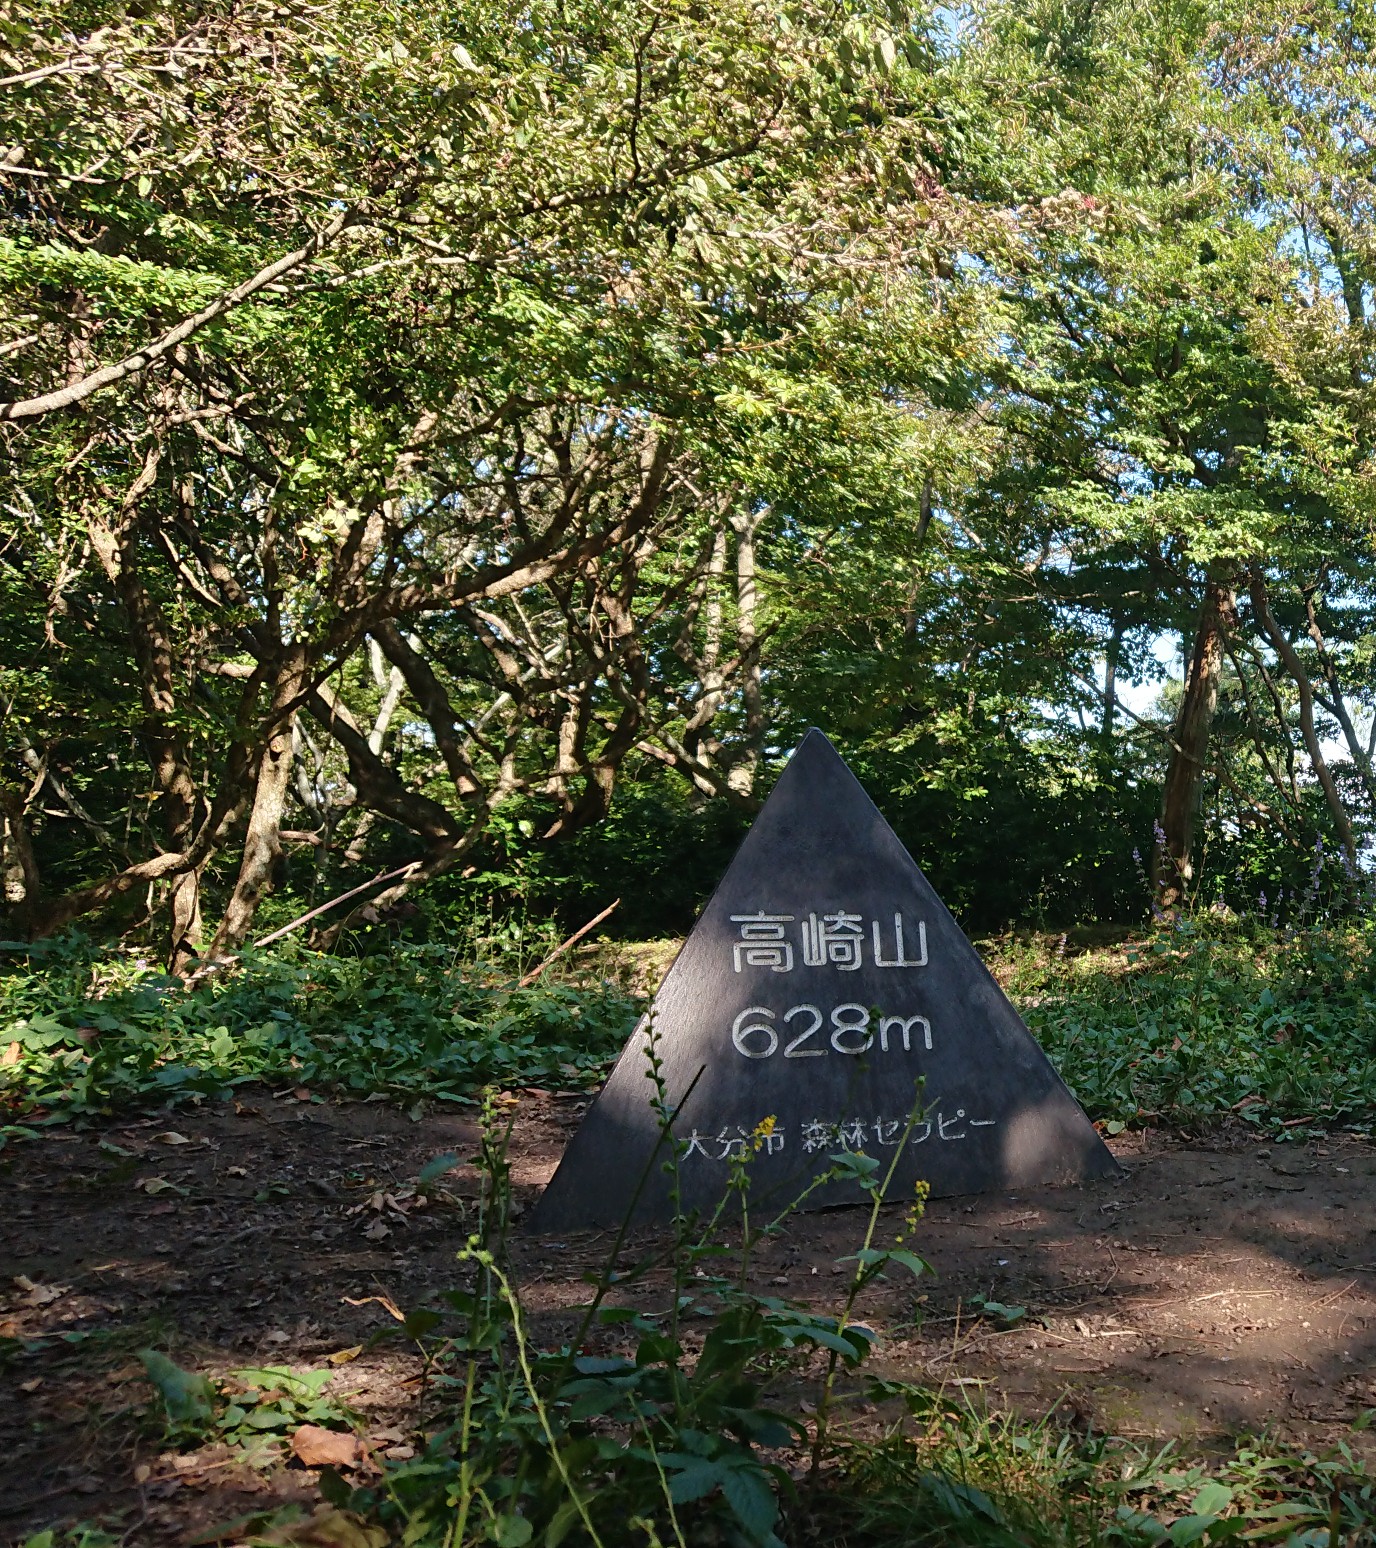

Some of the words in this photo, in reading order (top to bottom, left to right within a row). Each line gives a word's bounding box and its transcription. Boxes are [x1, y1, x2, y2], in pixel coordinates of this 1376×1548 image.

[730, 909, 928, 973] 高崎山
[731, 1003, 933, 1059] 628m
[801, 1109, 996, 1154] 森林セラピー
